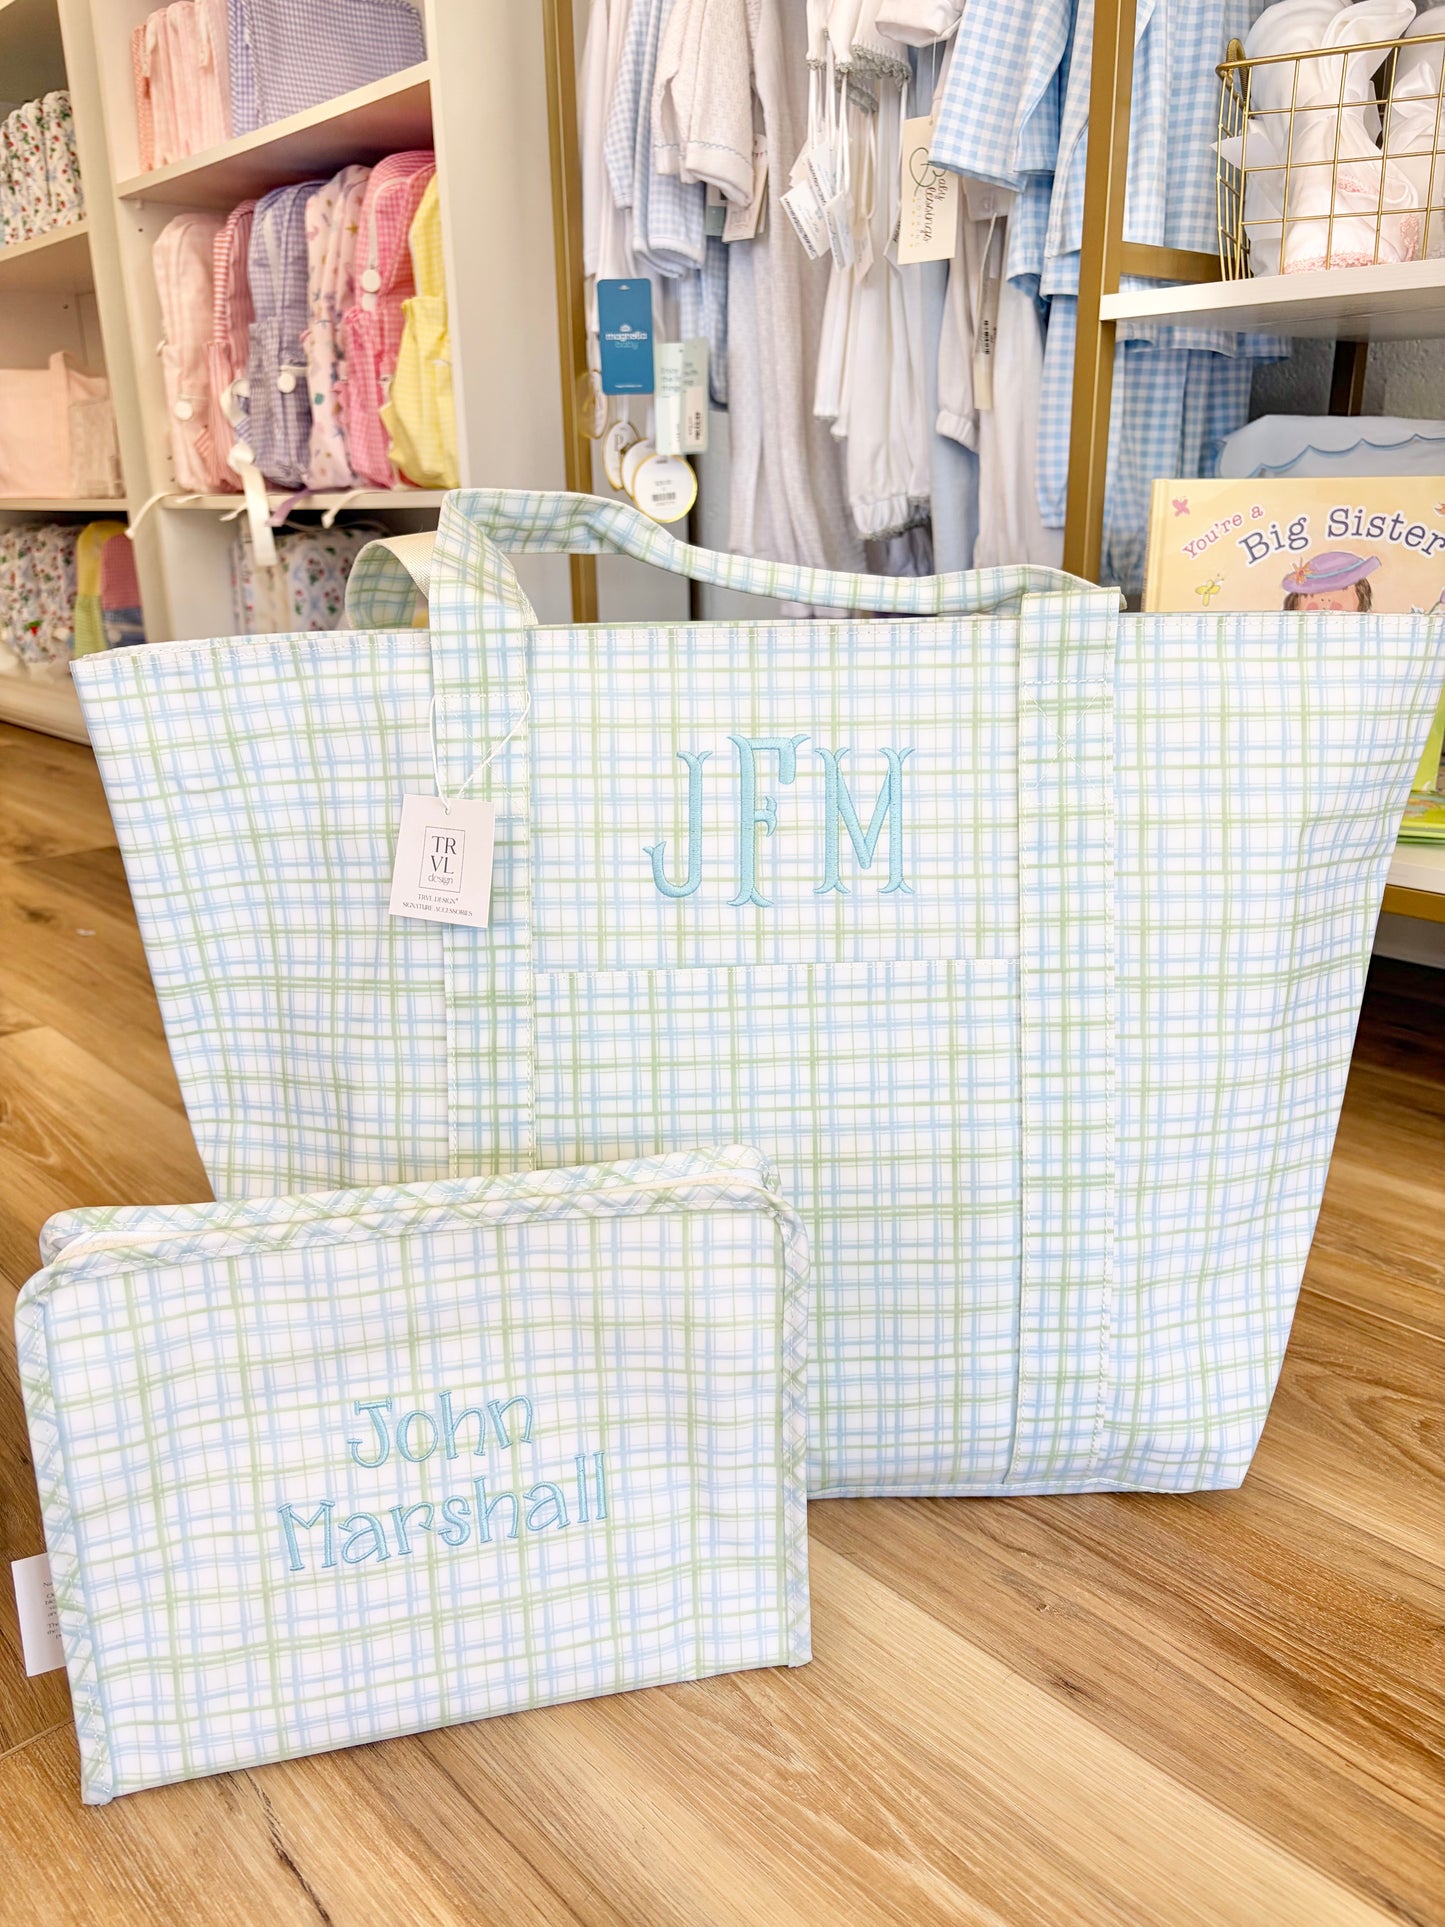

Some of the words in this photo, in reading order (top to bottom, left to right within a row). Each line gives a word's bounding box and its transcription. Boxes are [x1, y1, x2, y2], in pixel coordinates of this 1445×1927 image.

[1182, 513, 1243, 559] You're
[1250, 505, 1264, 519] a
[1238, 516, 1309, 564] Big
[1327, 507, 1445, 556] Sister
[643, 734, 916, 908] JFM
[428, 873, 454, 886] design
[347, 1389, 534, 1469] John
[277, 1450, 608, 1572] Marshall
